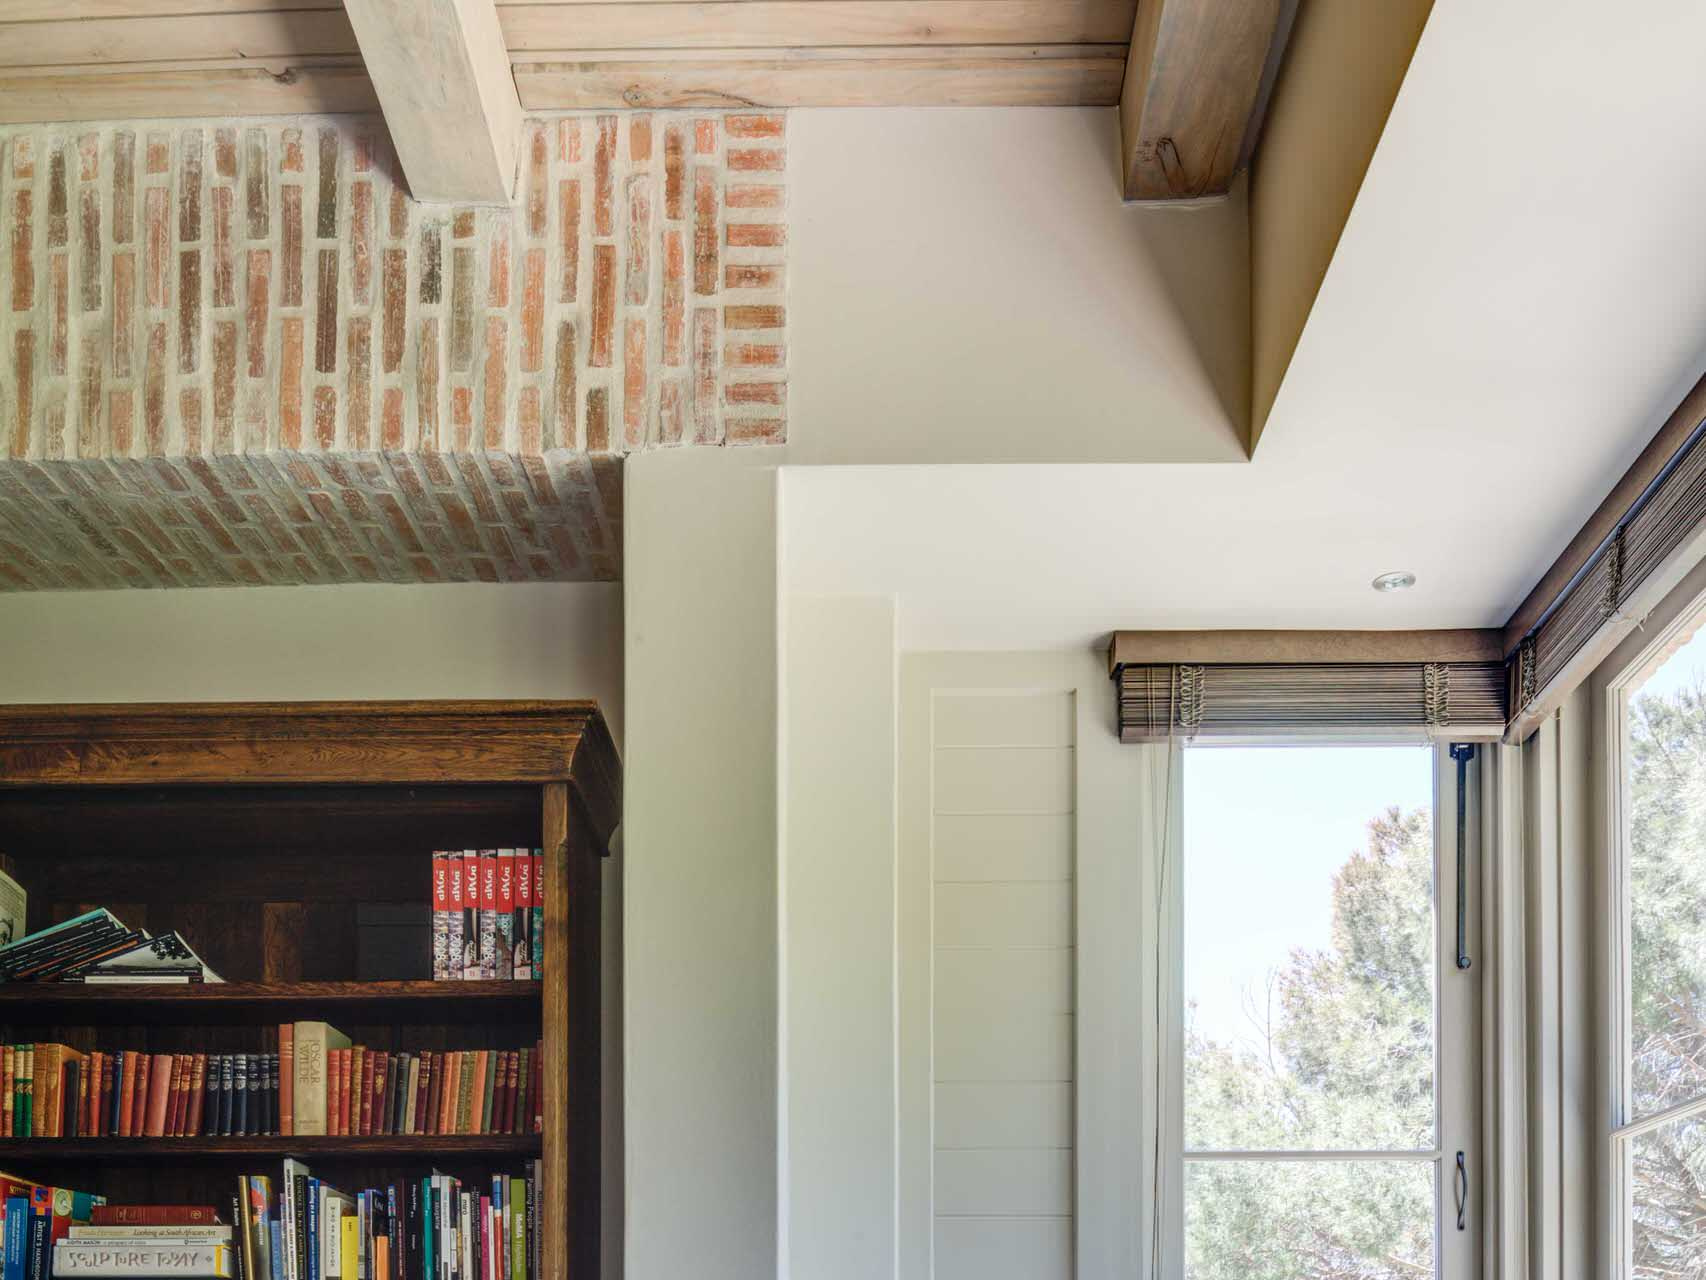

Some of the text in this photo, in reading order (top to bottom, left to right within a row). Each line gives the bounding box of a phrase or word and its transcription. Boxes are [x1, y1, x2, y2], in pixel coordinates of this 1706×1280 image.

[434, 933, 447, 961] 2008
[450, 934, 462, 961] 2008
[482, 932, 495, 960] 2008
[299, 1043, 309, 1085] WILDE
[310, 1042, 321, 1086] OSCAR
[526, 1178, 534, 1230] Painting People
[515, 1213, 523, 1239] MoMA
[34, 1247, 42, 1280] HANDBOOK
[69, 1251, 198, 1268] SCULPTURE TODAY
